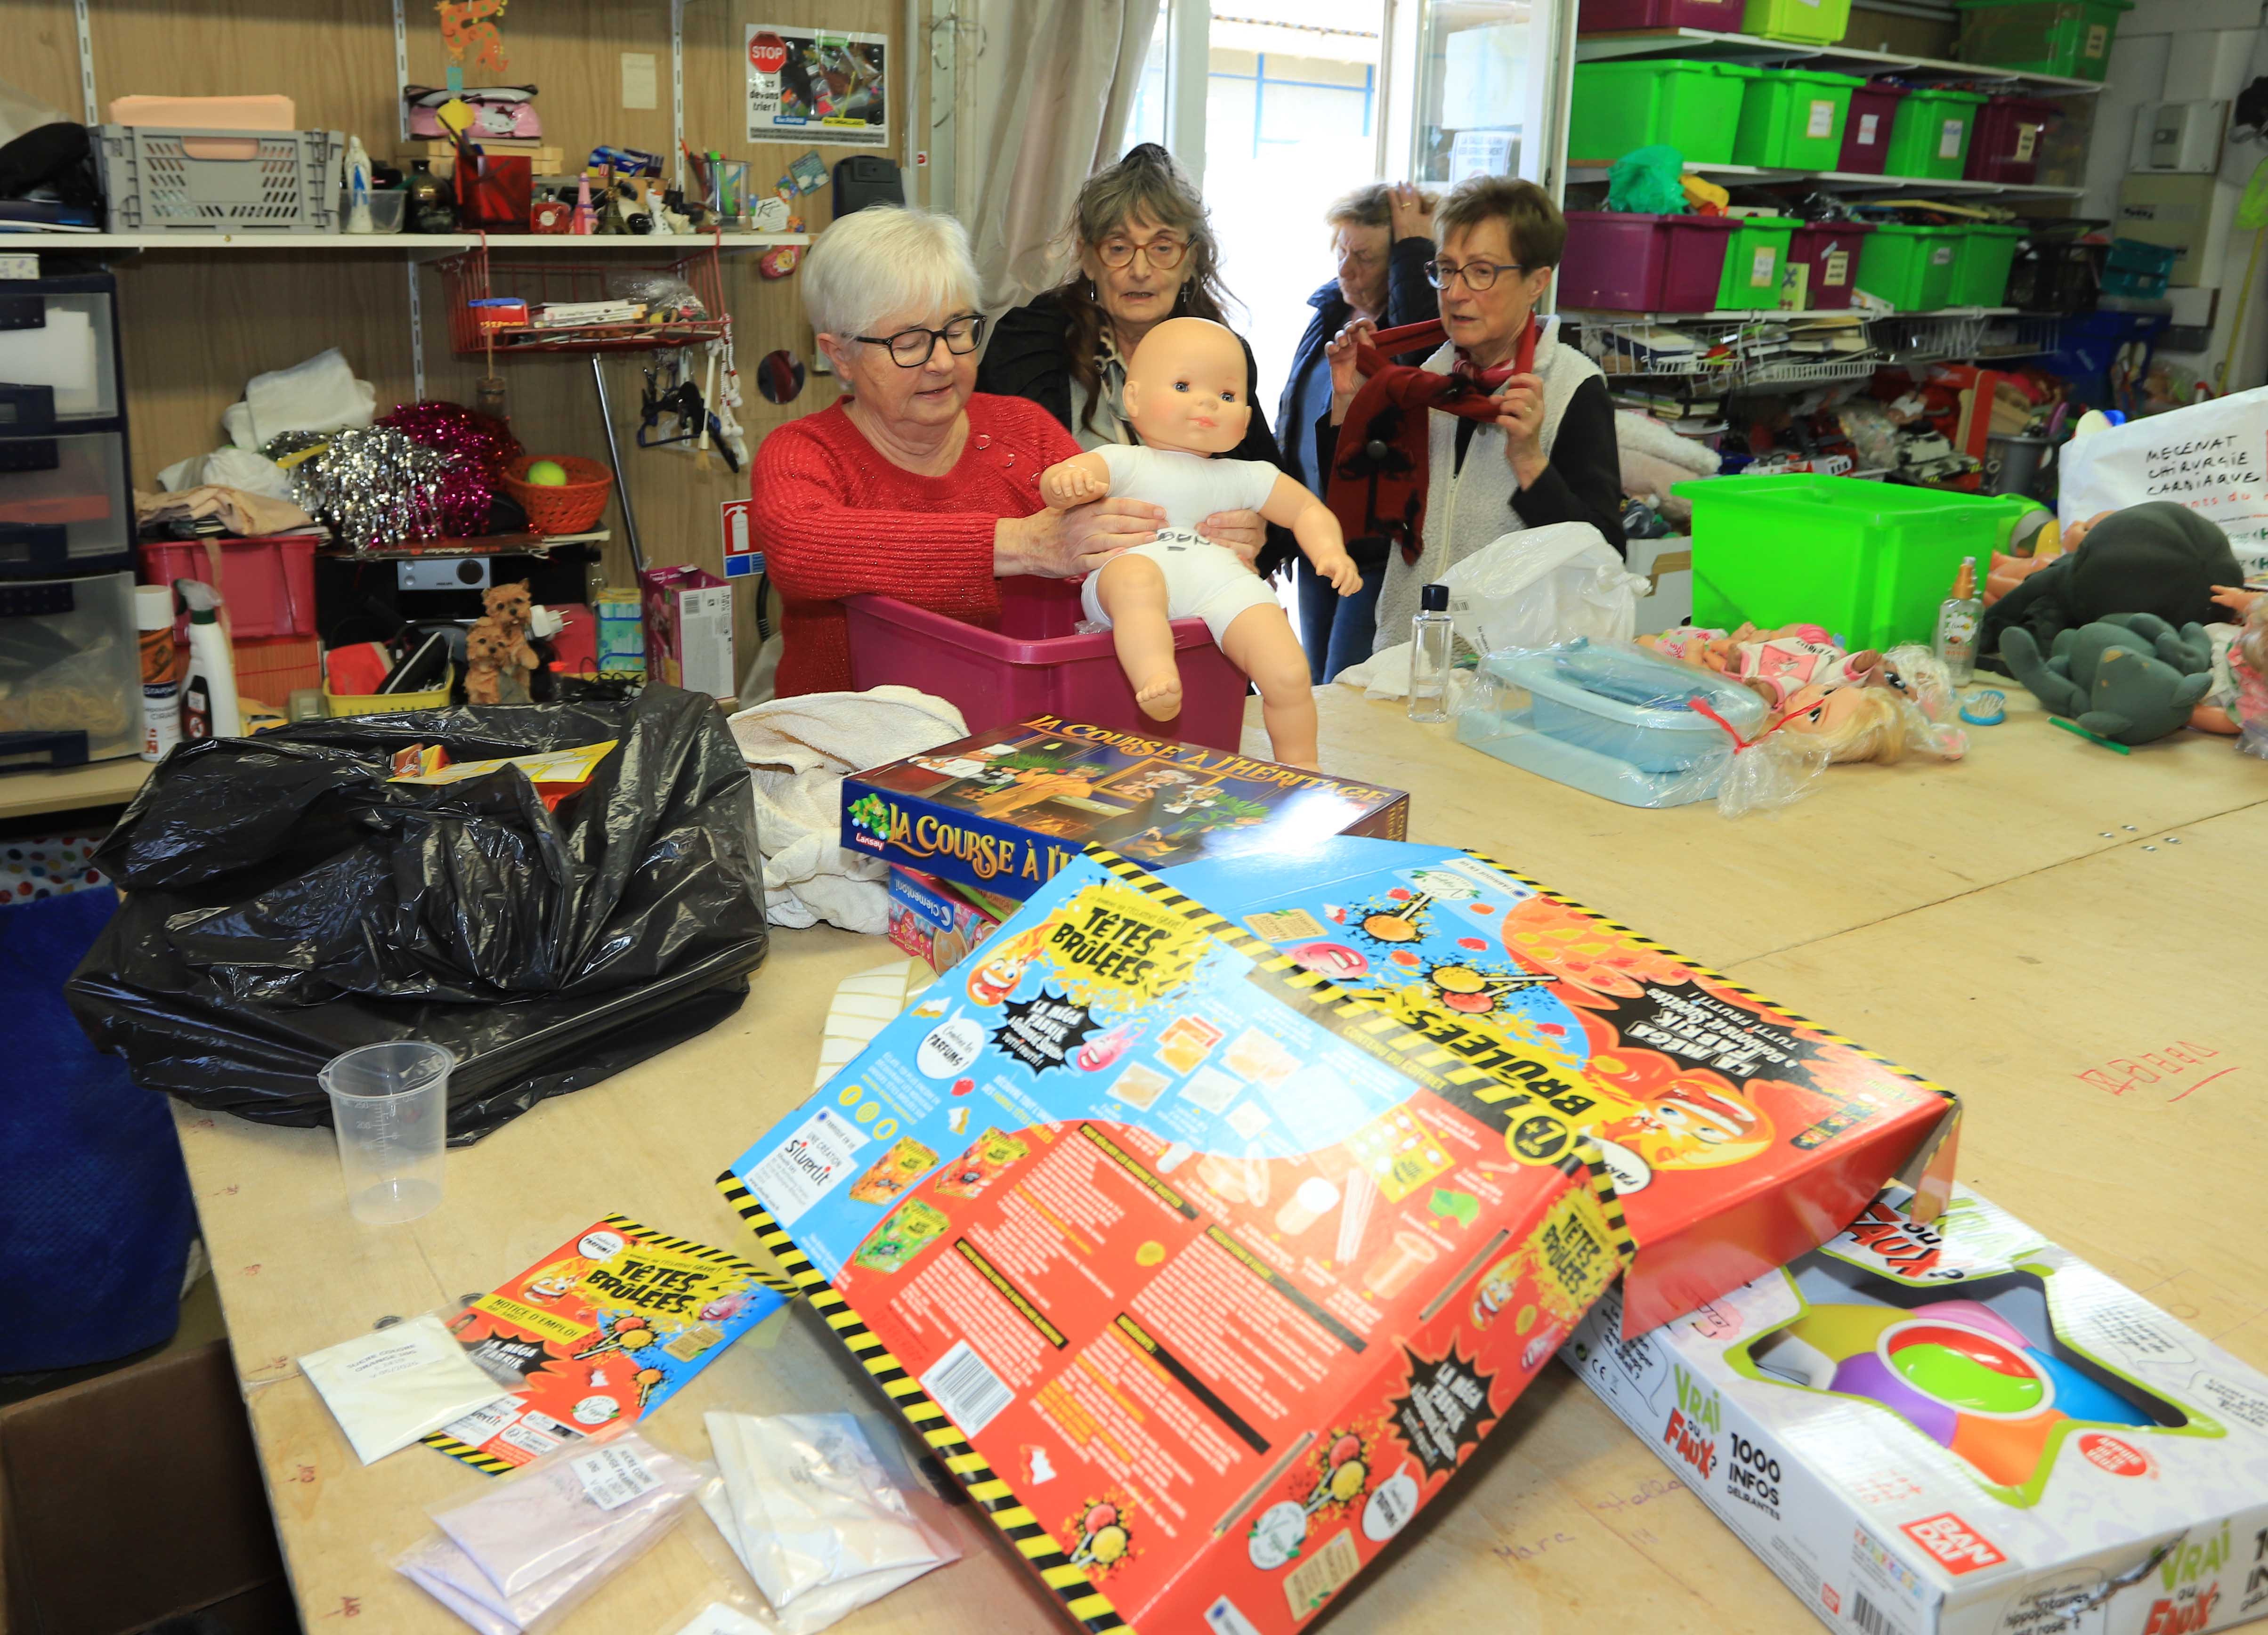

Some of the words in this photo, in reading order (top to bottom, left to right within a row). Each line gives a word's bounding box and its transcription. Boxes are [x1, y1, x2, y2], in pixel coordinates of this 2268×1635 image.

[752, 46, 783, 59] STOP
[749, 90, 779, 99] devons
[2146, 435, 2237, 462] MECENAT
[1061, 723, 1186, 761] COURSE
[855, 832, 884, 851] Lansay
[915, 815, 1015, 880] COURSE
[1022, 839, 1039, 881] À
[894, 878, 940, 917] Clementoni
[1084, 907, 1172, 956] TÊTES
[1050, 922, 1155, 986] BRÛLÉES
[1689, 992, 1751, 1027] FRUTTI
[1025, 1014, 1069, 1044] FABRIK
[1651, 1008, 1762, 1068] FABRIK
[1744, 1022, 1799, 1051] TUTTI
[926, 1034, 964, 1067] PARFUMS
[1408, 1010, 1596, 1117] BRÛLÉES
[1710, 1053, 1761, 1078] LA
[783, 1134, 834, 1185] Silverlit
[586, 1270, 699, 1313] BRÛLÉES
[619, 1260, 709, 1292] TÊTES
[494, 1299, 529, 1316] NOTICE
[529, 1314, 580, 1337] D'EMPLOI
[347, 1354, 377, 1368] SUCRE
[1664, 1408, 1715, 1480] FAUX
[1688, 1420, 1701, 1438] ou
[1730, 1432, 1781, 1483] 1000
[1729, 1463, 1780, 1506] INFOS
[1909, 1523, 1966, 1561] DAI
[1935, 1517, 1997, 1564] BAN
